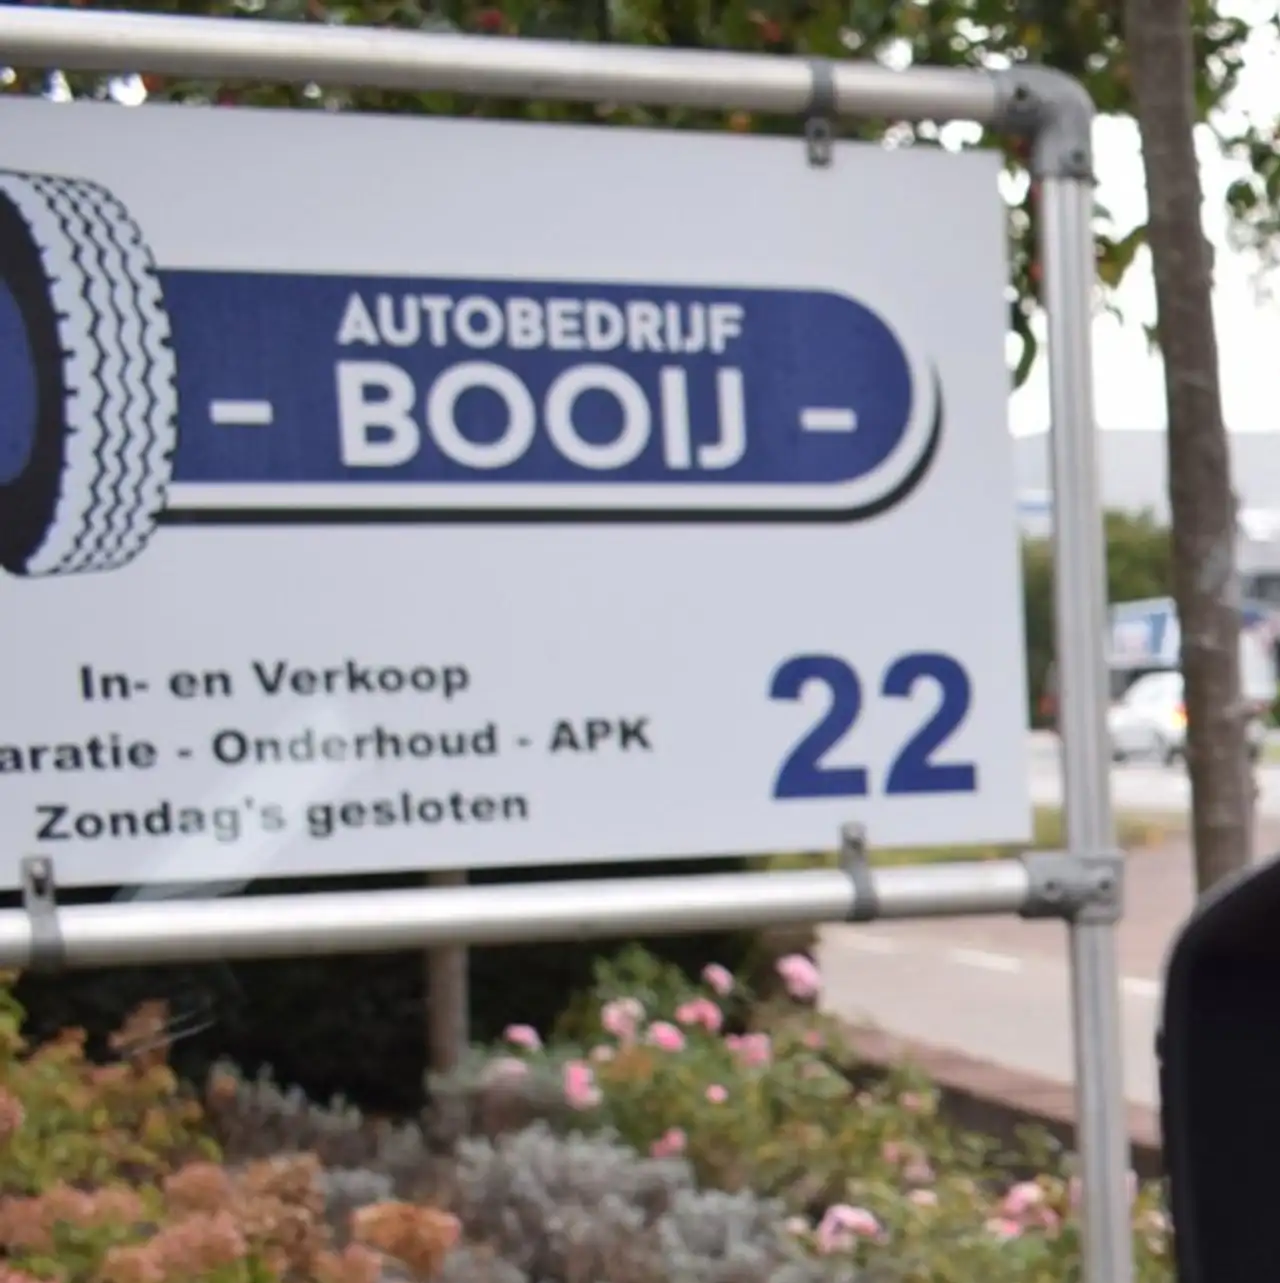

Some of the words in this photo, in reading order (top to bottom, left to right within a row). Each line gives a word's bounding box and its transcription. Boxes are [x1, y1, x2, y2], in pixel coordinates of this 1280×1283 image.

[336, 292, 744, 354] AUTOBEDRIJF
[336, 360, 746, 470] BOOIJ
[79, 663, 150, 701] In-
[167, 669, 234, 700] en
[251, 656, 470, 702] Verkoop
[210, 720, 499, 768] Onderhoud
[548, 716, 653, 754] APK
[768, 652, 978, 800] 22
[33, 796, 287, 844] Zondag's
[306, 789, 529, 840] gesloten
